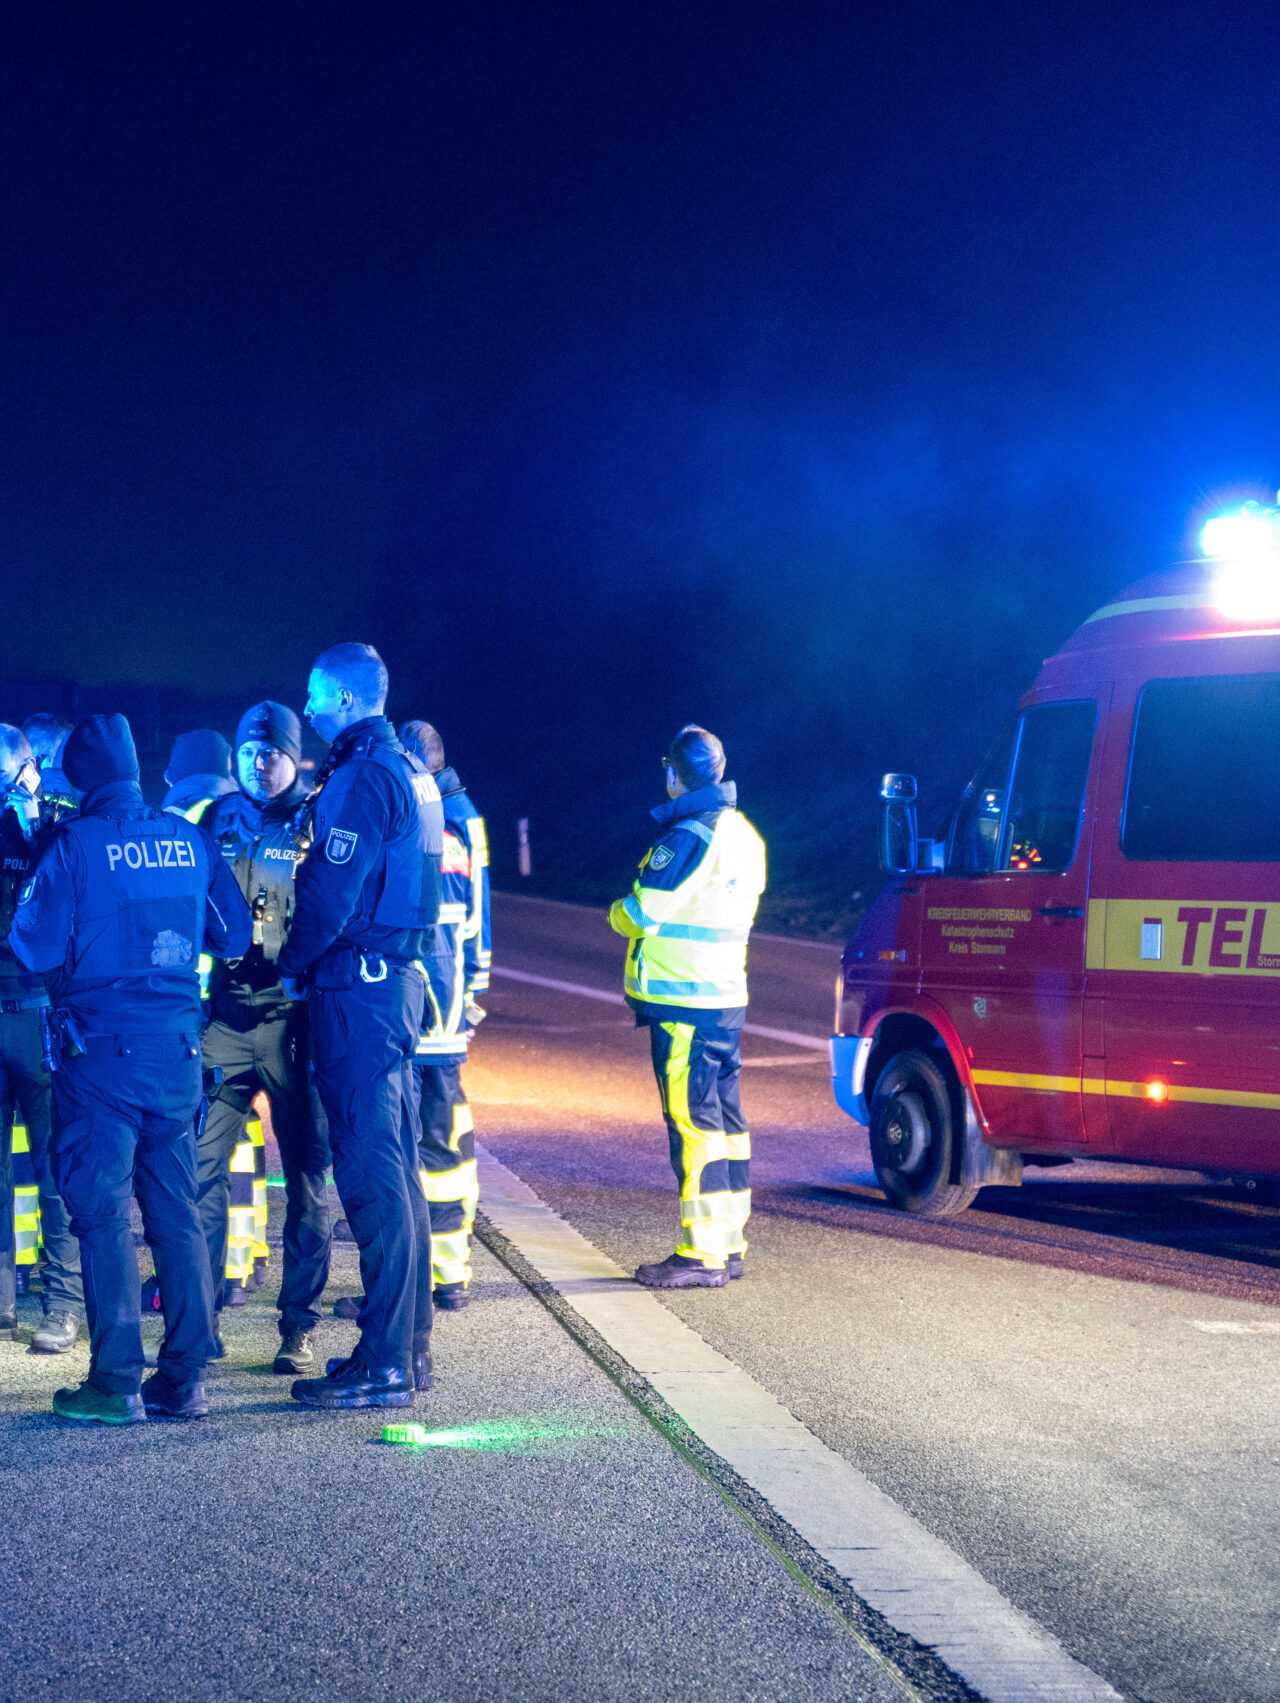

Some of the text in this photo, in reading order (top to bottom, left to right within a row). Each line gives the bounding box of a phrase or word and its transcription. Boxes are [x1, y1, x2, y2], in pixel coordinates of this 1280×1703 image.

[106, 840, 196, 871] POLIZEI
[941, 923, 1015, 940] Katastrophenschutz
[1176, 906, 1280, 970] TEL
[948, 941, 1006, 955] Kreis Stormarn
